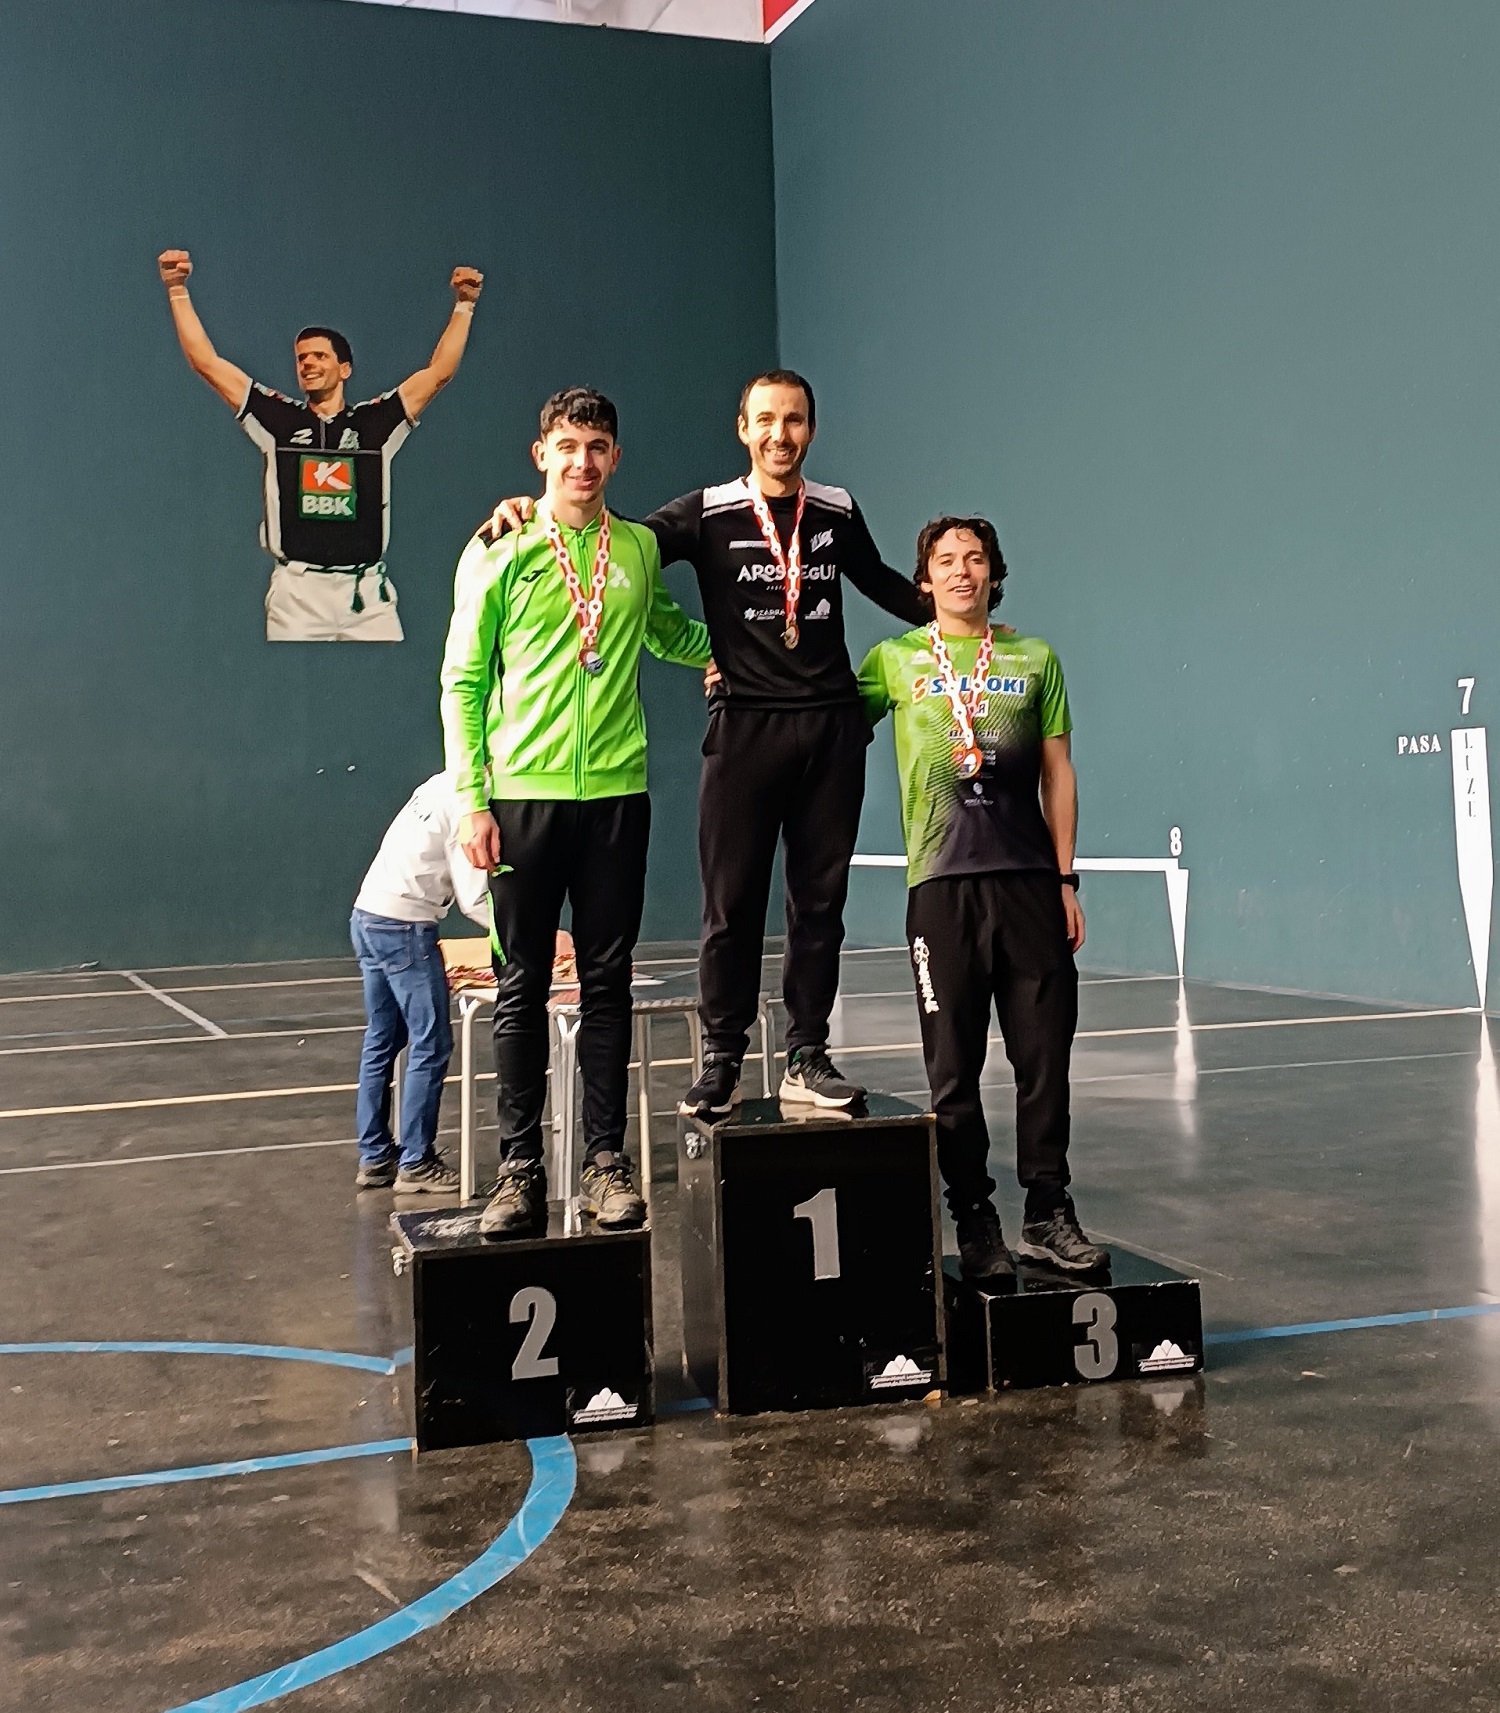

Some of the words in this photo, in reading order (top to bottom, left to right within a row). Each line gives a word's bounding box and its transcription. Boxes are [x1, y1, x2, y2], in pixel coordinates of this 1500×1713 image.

[302, 495, 353, 516] BBK
[737, 564, 836, 582] AROSEGUI
[931, 676, 1025, 694] SLOKI
[1457, 677, 1475, 715] 7
[1398, 734, 1442, 755] PASA
[1170, 826, 1182, 857] 8
[793, 1187, 841, 1281] 1
[509, 1286, 560, 1381] 2
[1072, 1293, 1119, 1380] 3
